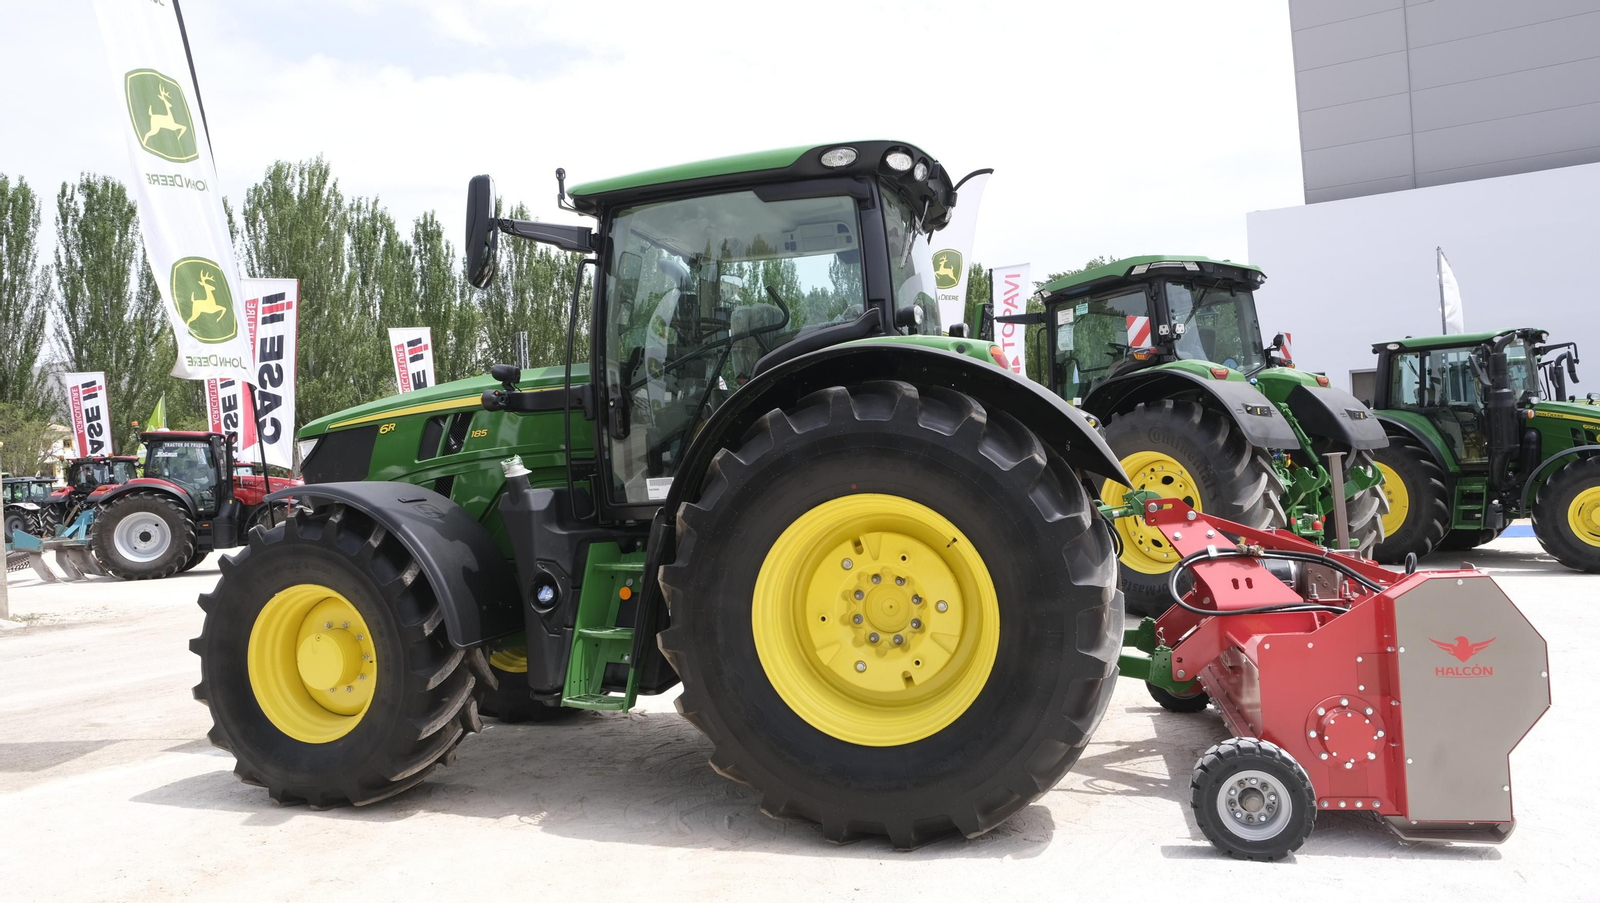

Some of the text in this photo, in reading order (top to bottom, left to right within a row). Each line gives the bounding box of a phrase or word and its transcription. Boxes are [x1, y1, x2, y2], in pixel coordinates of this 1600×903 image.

[941, 293, 960, 302] DEERE
[379, 422, 396, 435] 6R
[470, 428, 488, 438] 185
[1435, 663, 1493, 677] HALCÓN
